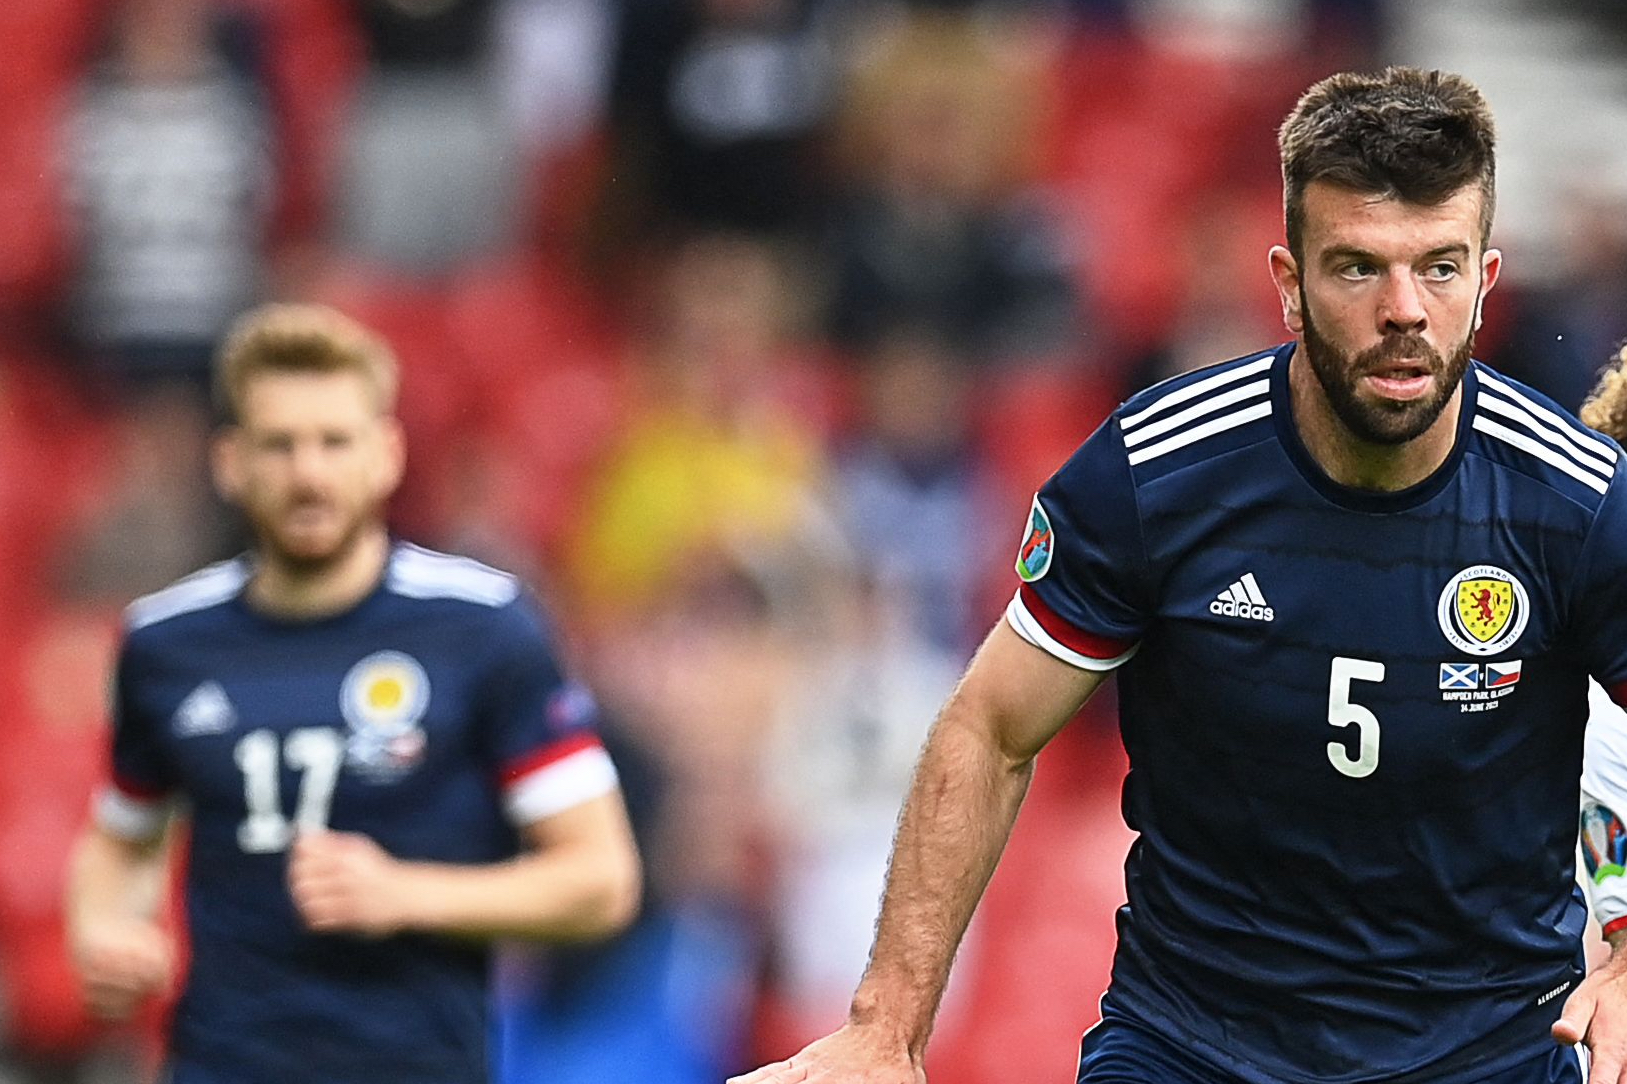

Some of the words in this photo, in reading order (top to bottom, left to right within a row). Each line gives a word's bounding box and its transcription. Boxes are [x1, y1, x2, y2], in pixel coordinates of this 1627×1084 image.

[1463, 569, 1507, 578] SCOTLAND
[1209, 601, 1274, 622] adidas
[1327, 656, 1386, 778] 5
[233, 727, 346, 854] 17
